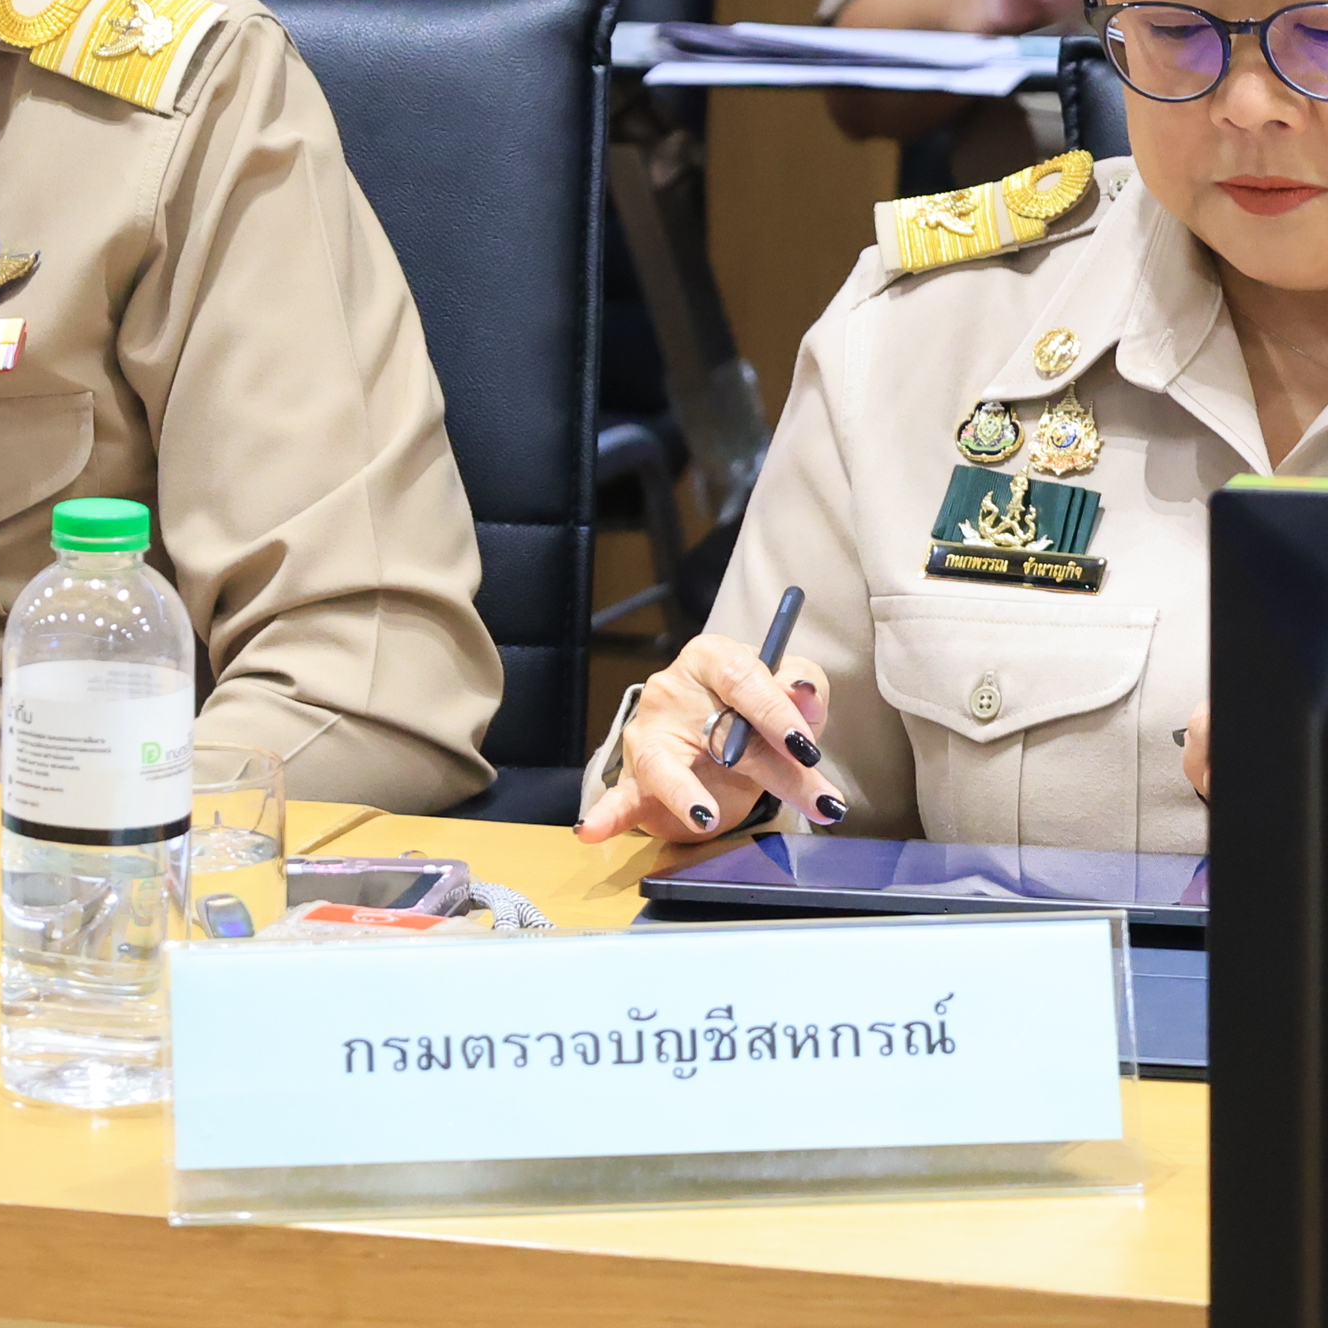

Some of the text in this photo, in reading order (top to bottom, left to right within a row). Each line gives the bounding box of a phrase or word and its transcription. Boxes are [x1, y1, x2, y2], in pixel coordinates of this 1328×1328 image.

[944, 553, 1083, 582] กนกพรรณ ชำนาญกิจ
[342, 992, 958, 1080] กรมตรวจบัญชีสหกรณ์
